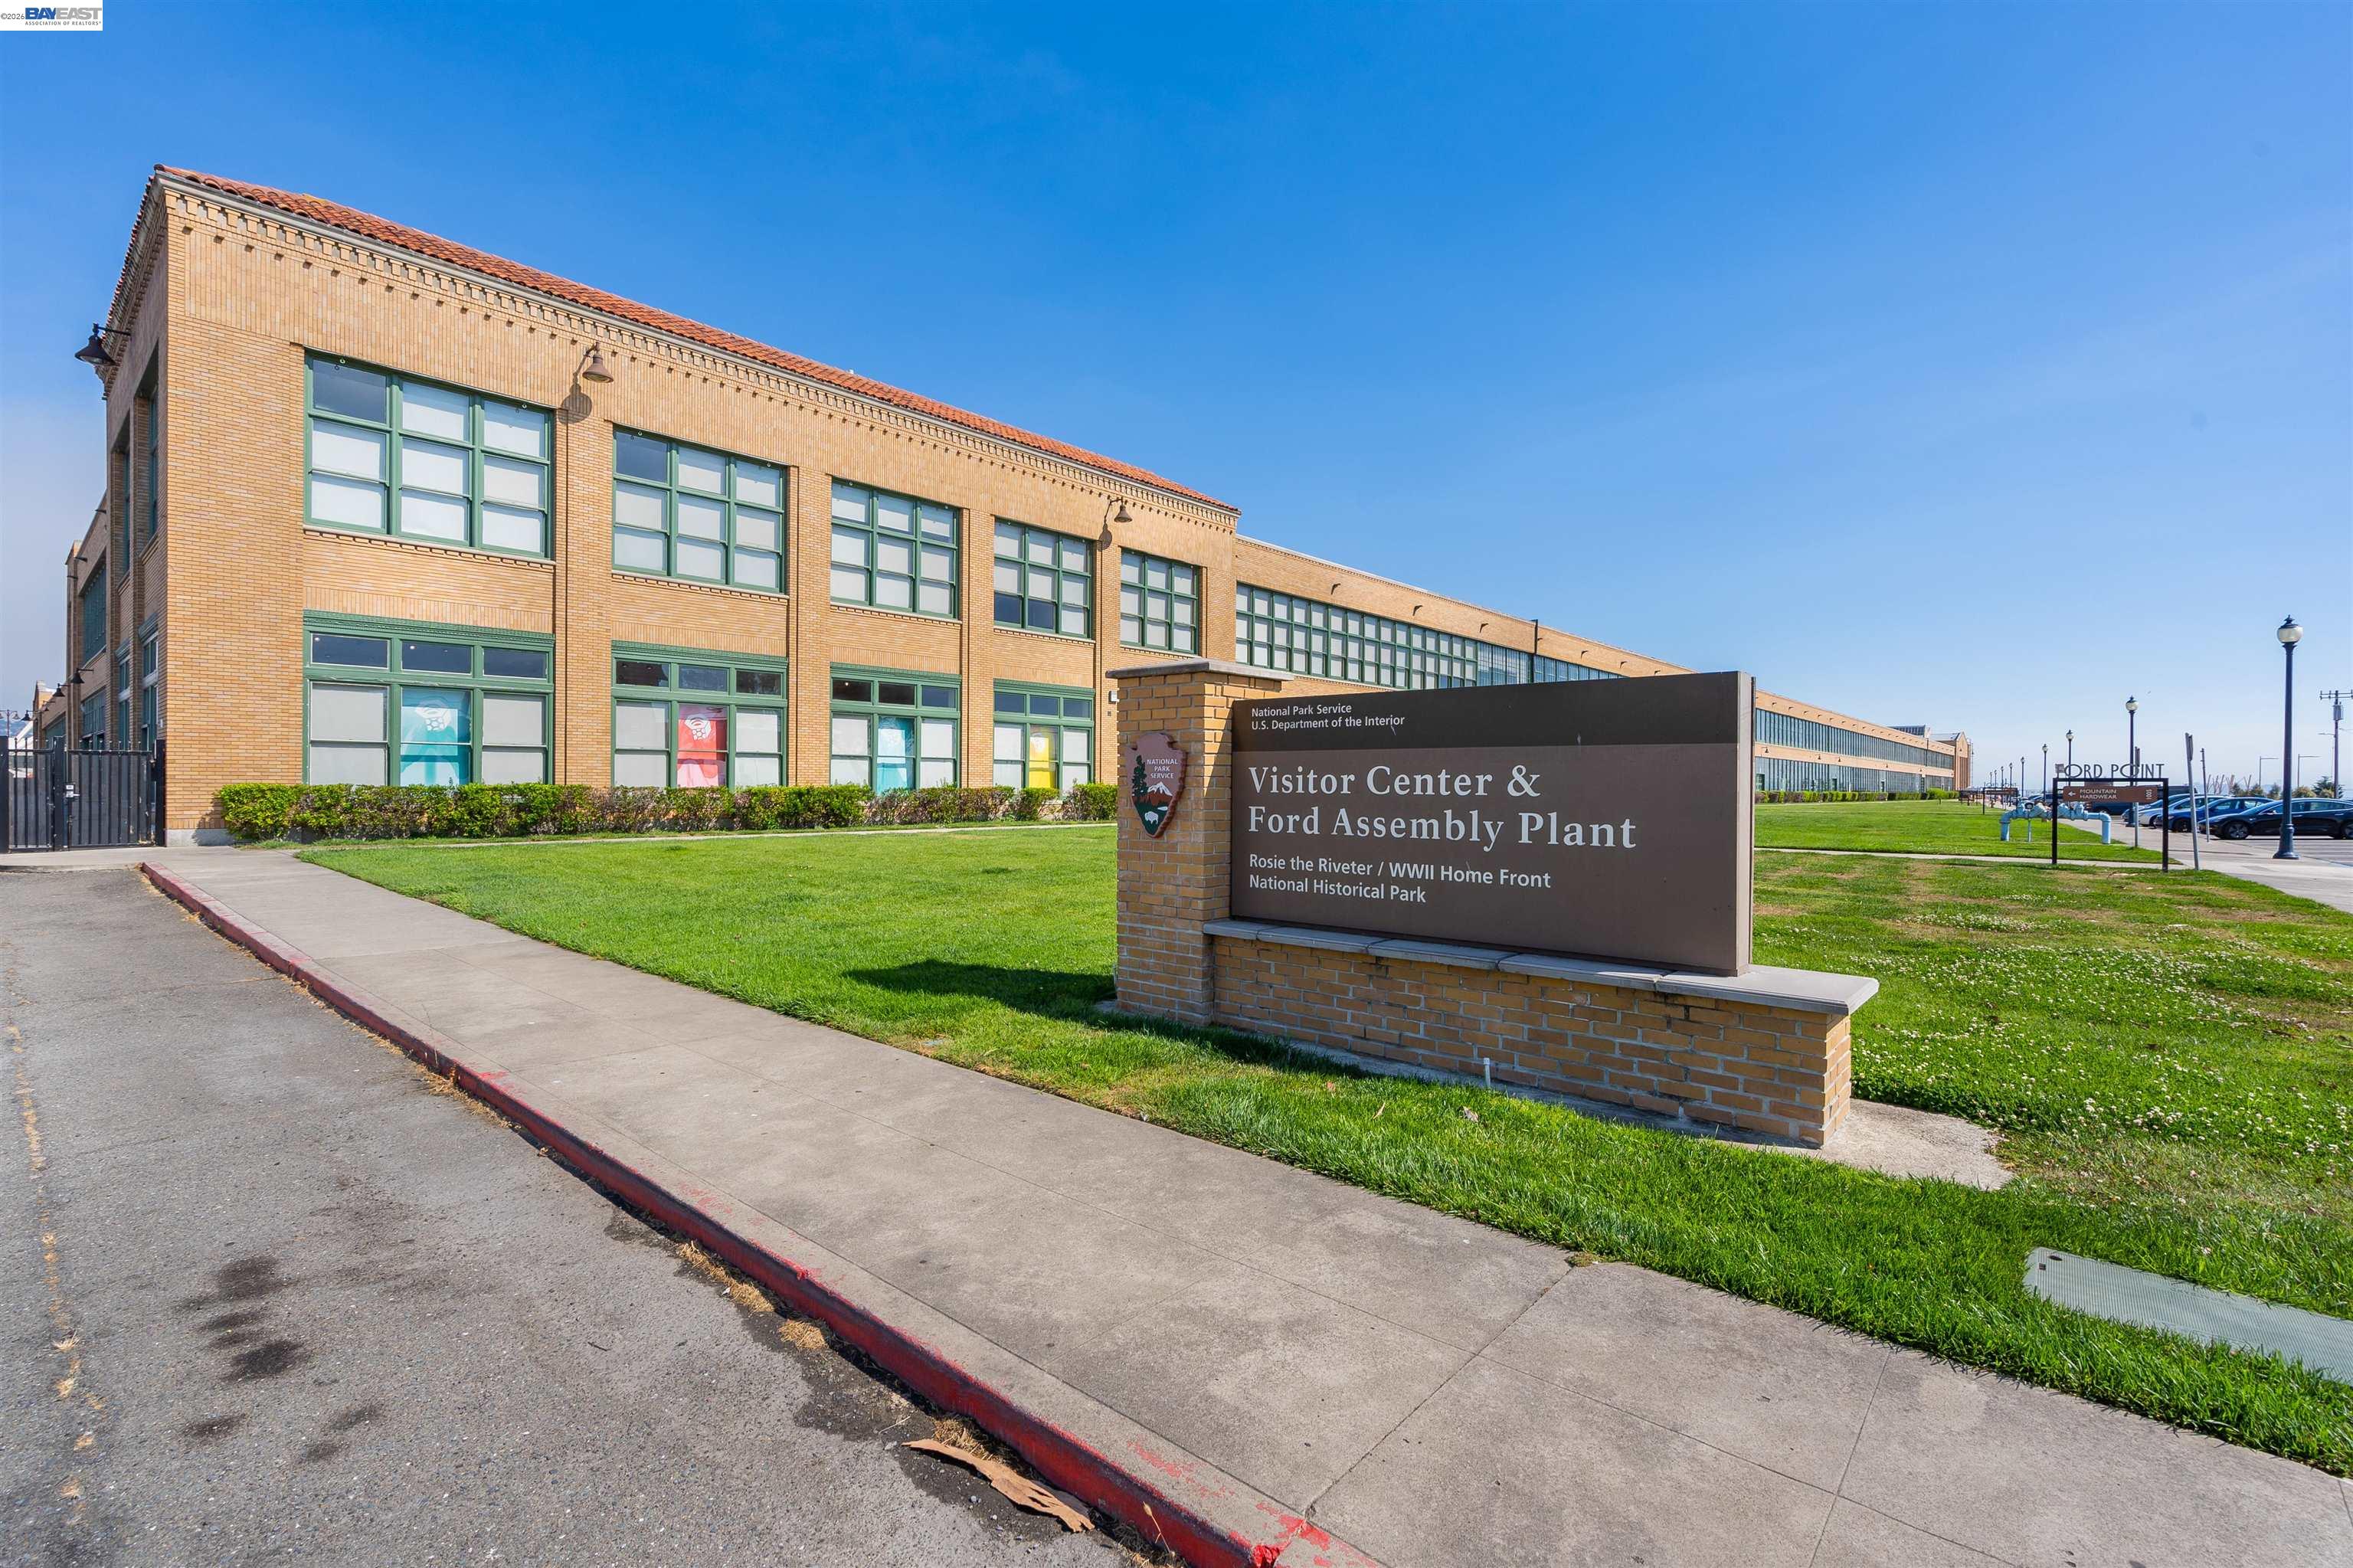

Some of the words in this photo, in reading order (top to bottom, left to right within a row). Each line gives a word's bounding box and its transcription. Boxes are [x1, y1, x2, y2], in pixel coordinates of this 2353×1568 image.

[1252, 705, 1290, 717] National
[1293, 704, 1314, 715] Park
[1317, 703, 1352, 715] Service
[1252, 720, 1268, 730] U.S.
[1272, 717, 1328, 732] Department
[1332, 716, 1342, 727] of
[1344, 716, 1362, 727] the
[1365, 715, 1406, 726] Interior
[1248, 766, 1355, 794] Visitor
[1366, 765, 1494, 796] Center
[1507, 764, 1541, 797] &
[2055, 764, 2103, 778] FORD
[2111, 764, 2165, 778] POINT
[1248, 806, 1320, 835] Ford
[1330, 807, 1504, 852] Assembly
[1518, 811, 1637, 848] Plant
[1250, 853, 1286, 869] Rosie
[1290, 856, 1314, 872] the
[1318, 858, 1373, 876] Riveter
[1377, 861, 1384, 877] /
[1389, 862, 1435, 880] WWII
[1441, 866, 1493, 885] Home
[1500, 869, 1551, 889] Front
[1250, 874, 1308, 892] National
[1314, 879, 1385, 899] Historical
[1390, 885, 1426, 903] Park
